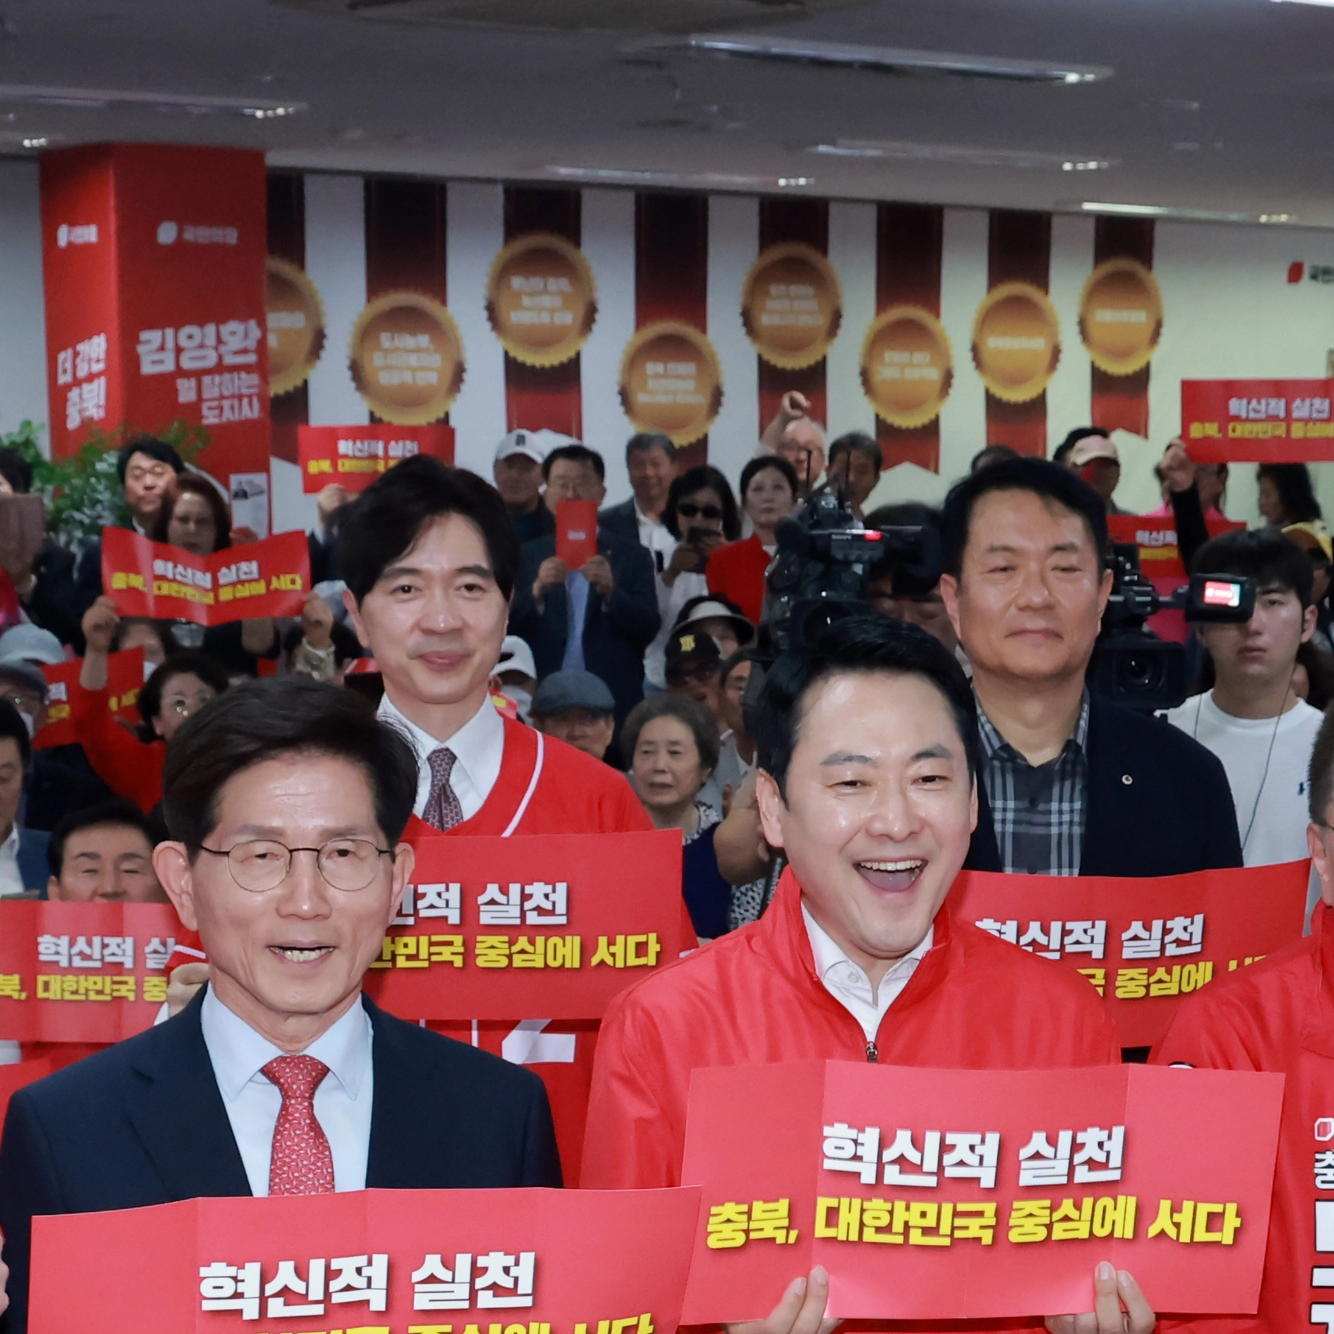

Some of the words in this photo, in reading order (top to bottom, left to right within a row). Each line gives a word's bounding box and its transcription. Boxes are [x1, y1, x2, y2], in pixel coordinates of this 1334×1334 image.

[136, 319, 262, 376] 김영환
[201, 395, 260, 426] 도지사
[477, 882, 569, 926] 실천
[37, 934, 135, 969] 혁신적
[474, 934, 582, 969] 중심에
[590, 932, 661, 969] 서다
[1120, 913, 1205, 960] 실천
[36, 974, 137, 1002] 대한민국
[1114, 960, 1214, 999] 중심에
[820, 1121, 1003, 1190] 혁신적
[1016, 1124, 1128, 1186] 실천
[703, 1197, 801, 1250] 충북,
[813, 1195, 999, 1249] 대한민국
[1007, 1195, 1139, 1245] 중심에
[1146, 1199, 1243, 1246] 서다
[197, 1253, 390, 1321] 혁신적
[410, 1250, 538, 1311] 실천
